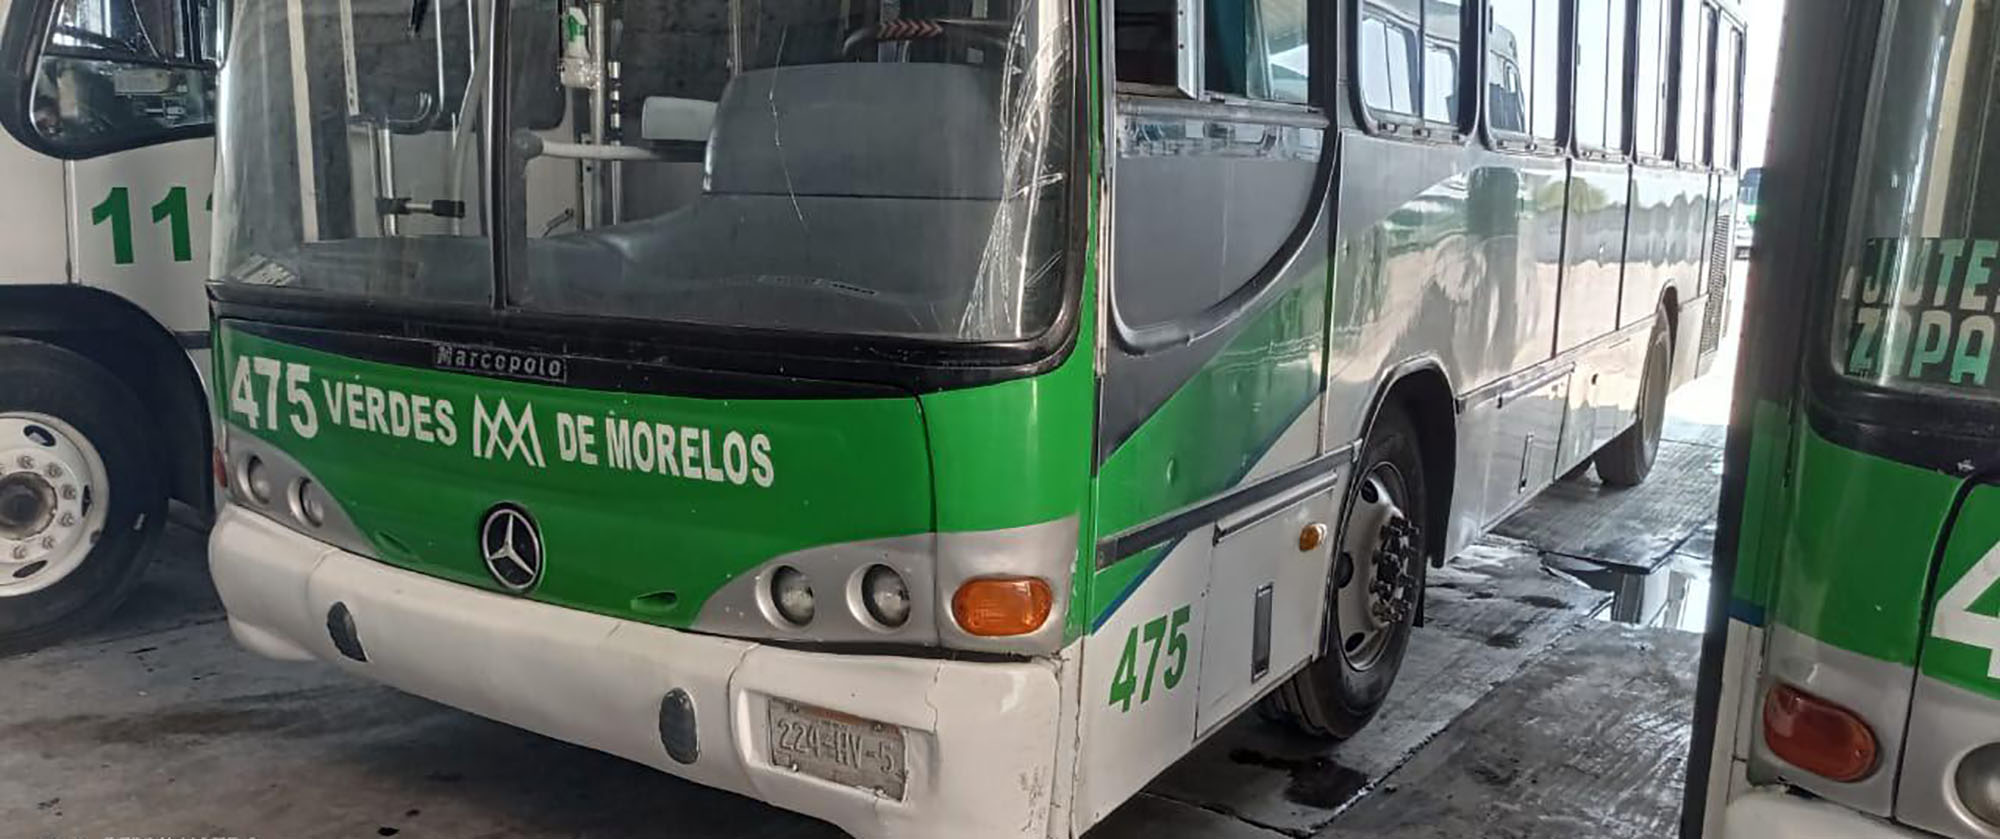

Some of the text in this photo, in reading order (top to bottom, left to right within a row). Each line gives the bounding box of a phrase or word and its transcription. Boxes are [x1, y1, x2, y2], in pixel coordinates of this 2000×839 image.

[91, 186, 213, 264] 11
[231, 355, 318, 438] 475
[437, 344, 561, 377] Marcopolo
[321, 378, 457, 446] VERDES
[556, 411, 599, 465] DE
[605, 416, 774, 488] MORELOS
[1109, 604, 1191, 712] 475
